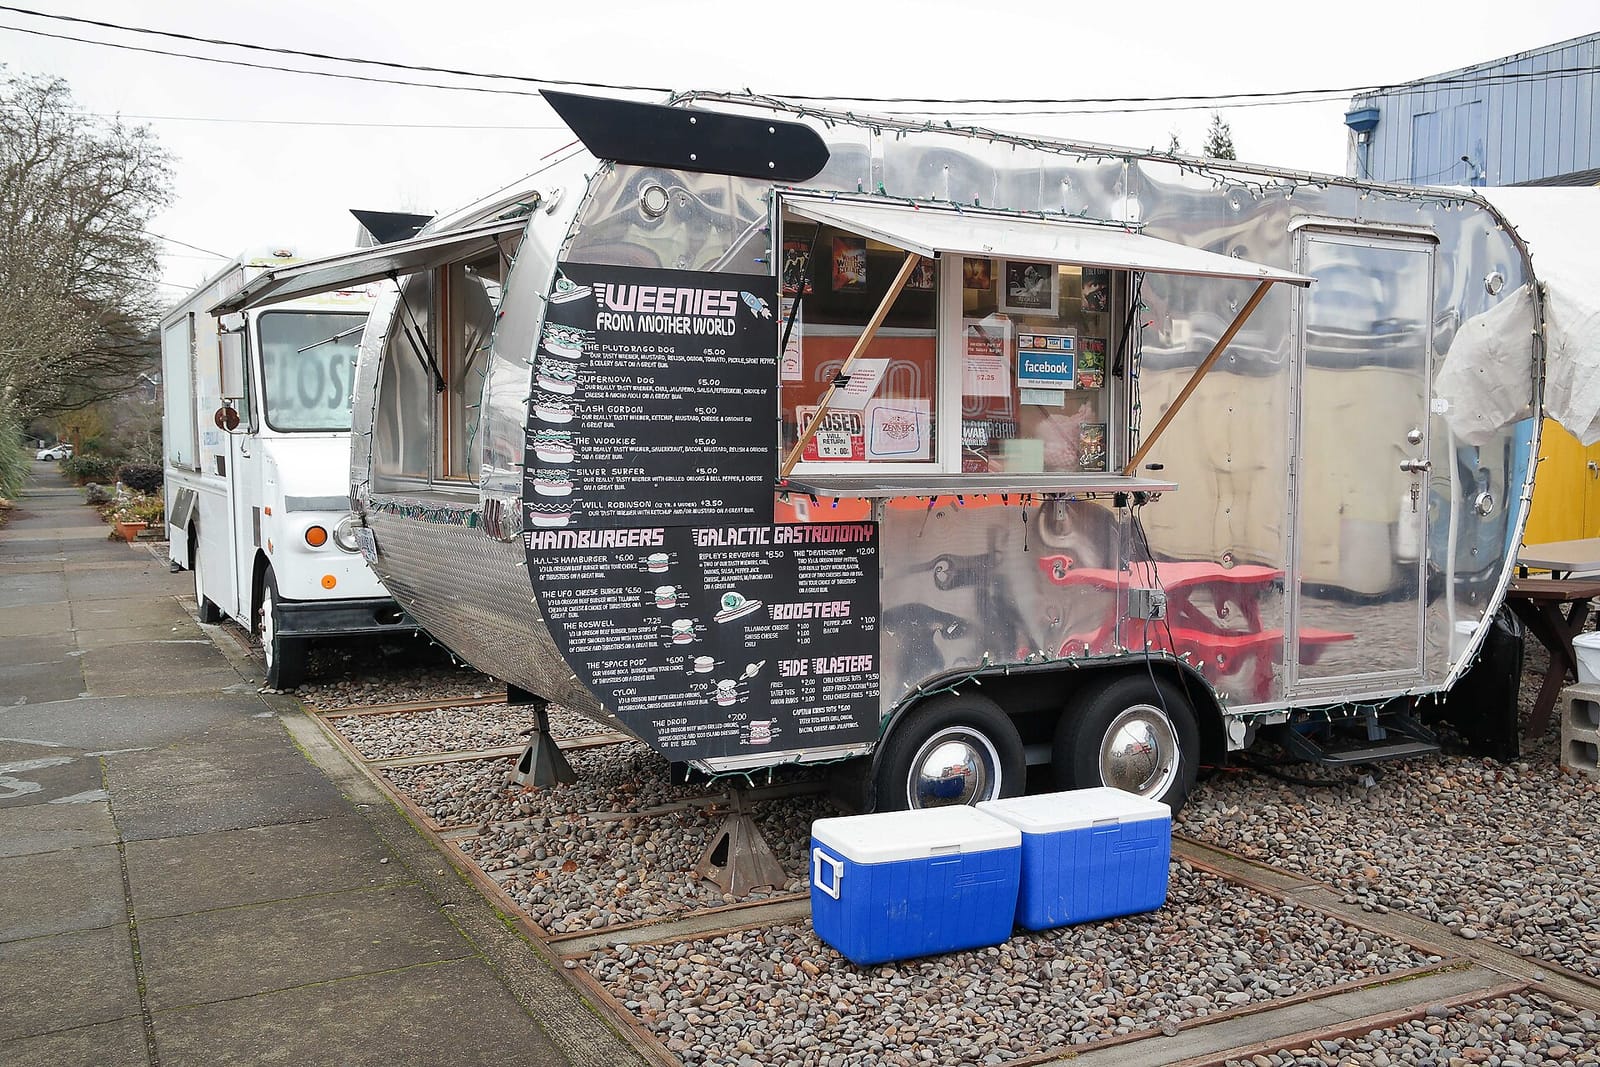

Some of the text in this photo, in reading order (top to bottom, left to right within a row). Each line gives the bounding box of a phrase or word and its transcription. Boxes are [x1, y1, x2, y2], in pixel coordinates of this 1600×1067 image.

[605, 284, 738, 316] WEENIES
[596, 312, 736, 336] FROM ANOTHER WORLD
[1025, 360, 1068, 374] facebook
[578, 375, 632, 384] SUPERNOVA
[575, 404, 604, 412] FLASH
[530, 528, 665, 550] HAMBURGERS
[698, 525, 873, 547] GALACTIC GASTRONOMY
[560, 556, 608, 564] HAMBURGER
[773, 600, 851, 620] BOOSTERS
[578, 620, 614, 628] ROSWELL
[602, 660, 628, 668] "SPACE
[782, 655, 872, 677] SIDE BLASTERS
[612, 688, 636, 696] CYLON
[728, 713, 746, 721] $7.00
